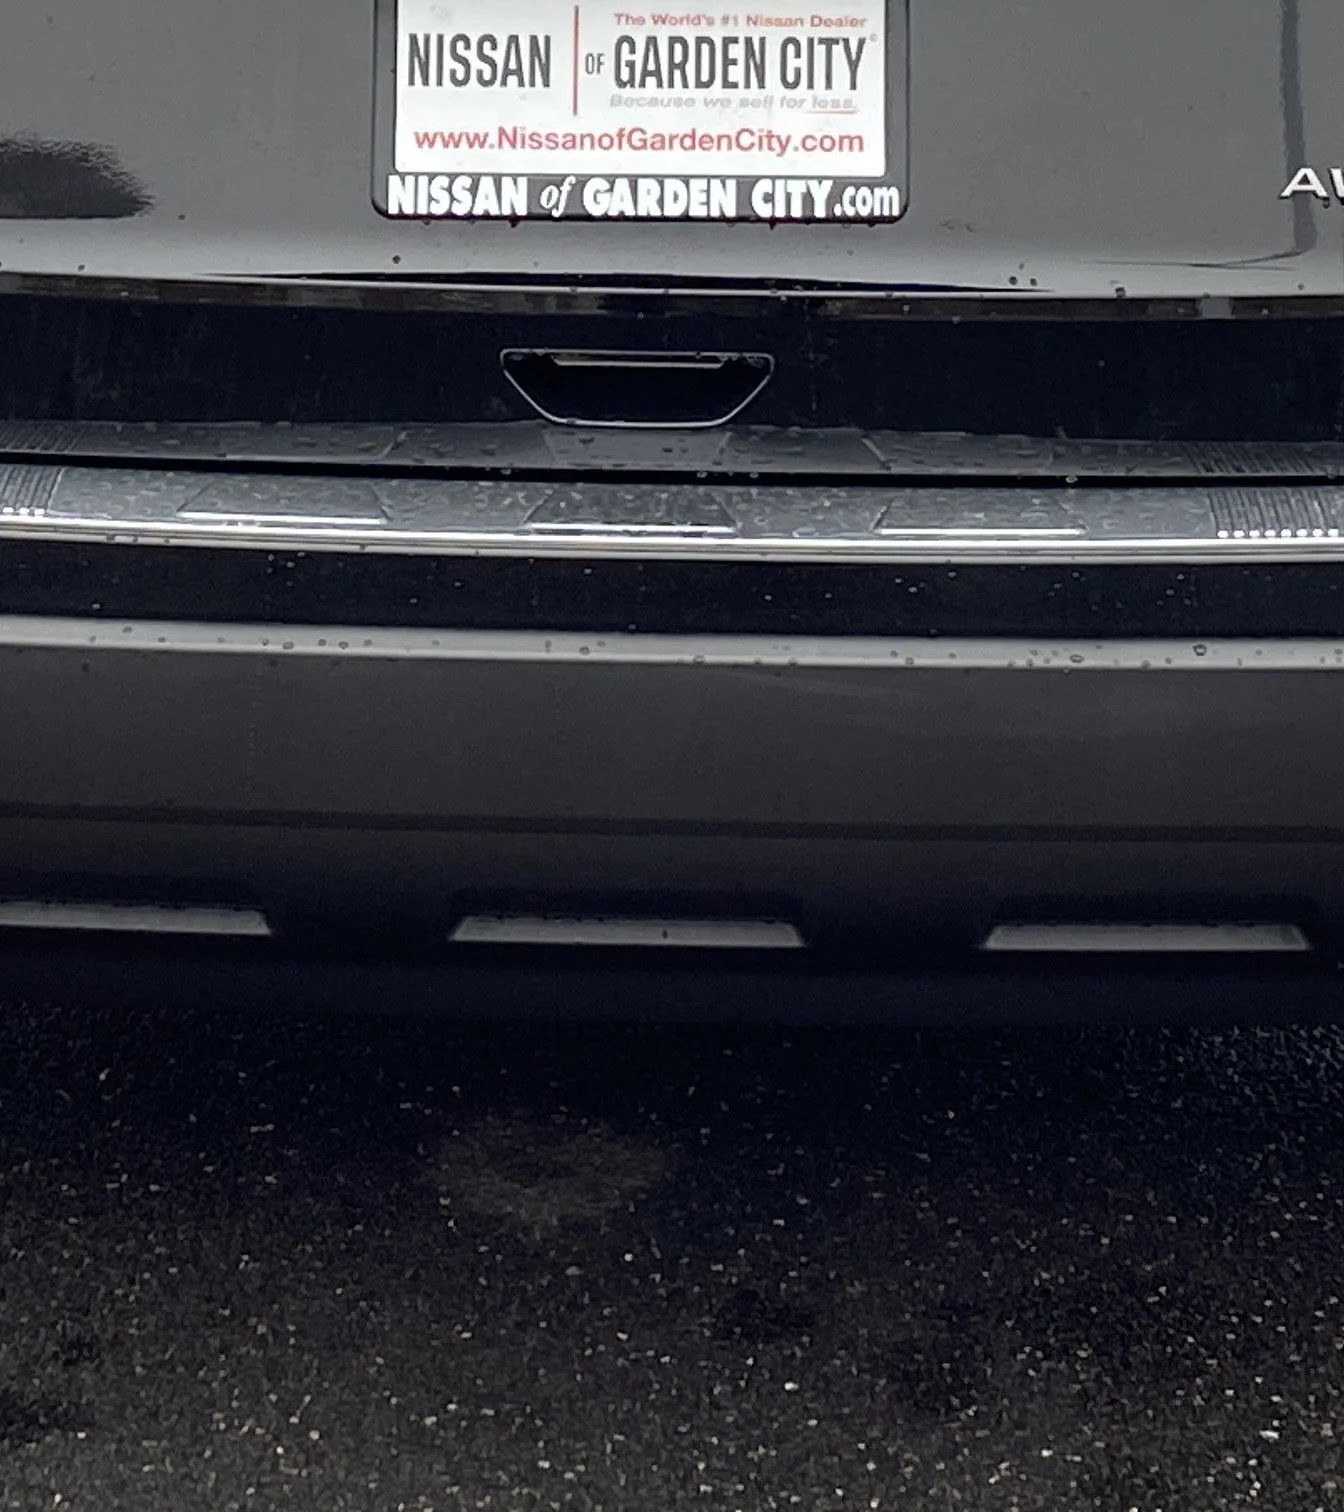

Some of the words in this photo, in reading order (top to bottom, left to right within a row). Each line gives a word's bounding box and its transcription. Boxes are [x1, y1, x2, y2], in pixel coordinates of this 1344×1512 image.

[614, 12, 646, 26] The
[651, 13, 715, 26] World's
[720, 13, 739, 27] #1
[746, 14, 804, 28] Nissan
[810, 15, 867, 28] Dealer
[407, 32, 552, 88] NISSAN
[584, 52, 605, 75] OF
[614, 34, 766, 90] GARDEN
[779, 35, 867, 91] CITY
[609, 94, 696, 108] Because
[703, 96, 733, 108] we
[739, 94, 774, 109] sell
[779, 94, 806, 109] for
[414, 125, 865, 157] www.NissanofGardenCity.com
[387, 174, 528, 216] NISSAN
[539, 174, 575, 217] of
[582, 176, 737, 217] GARDEN
[751, 178, 900, 218] CITY.com
